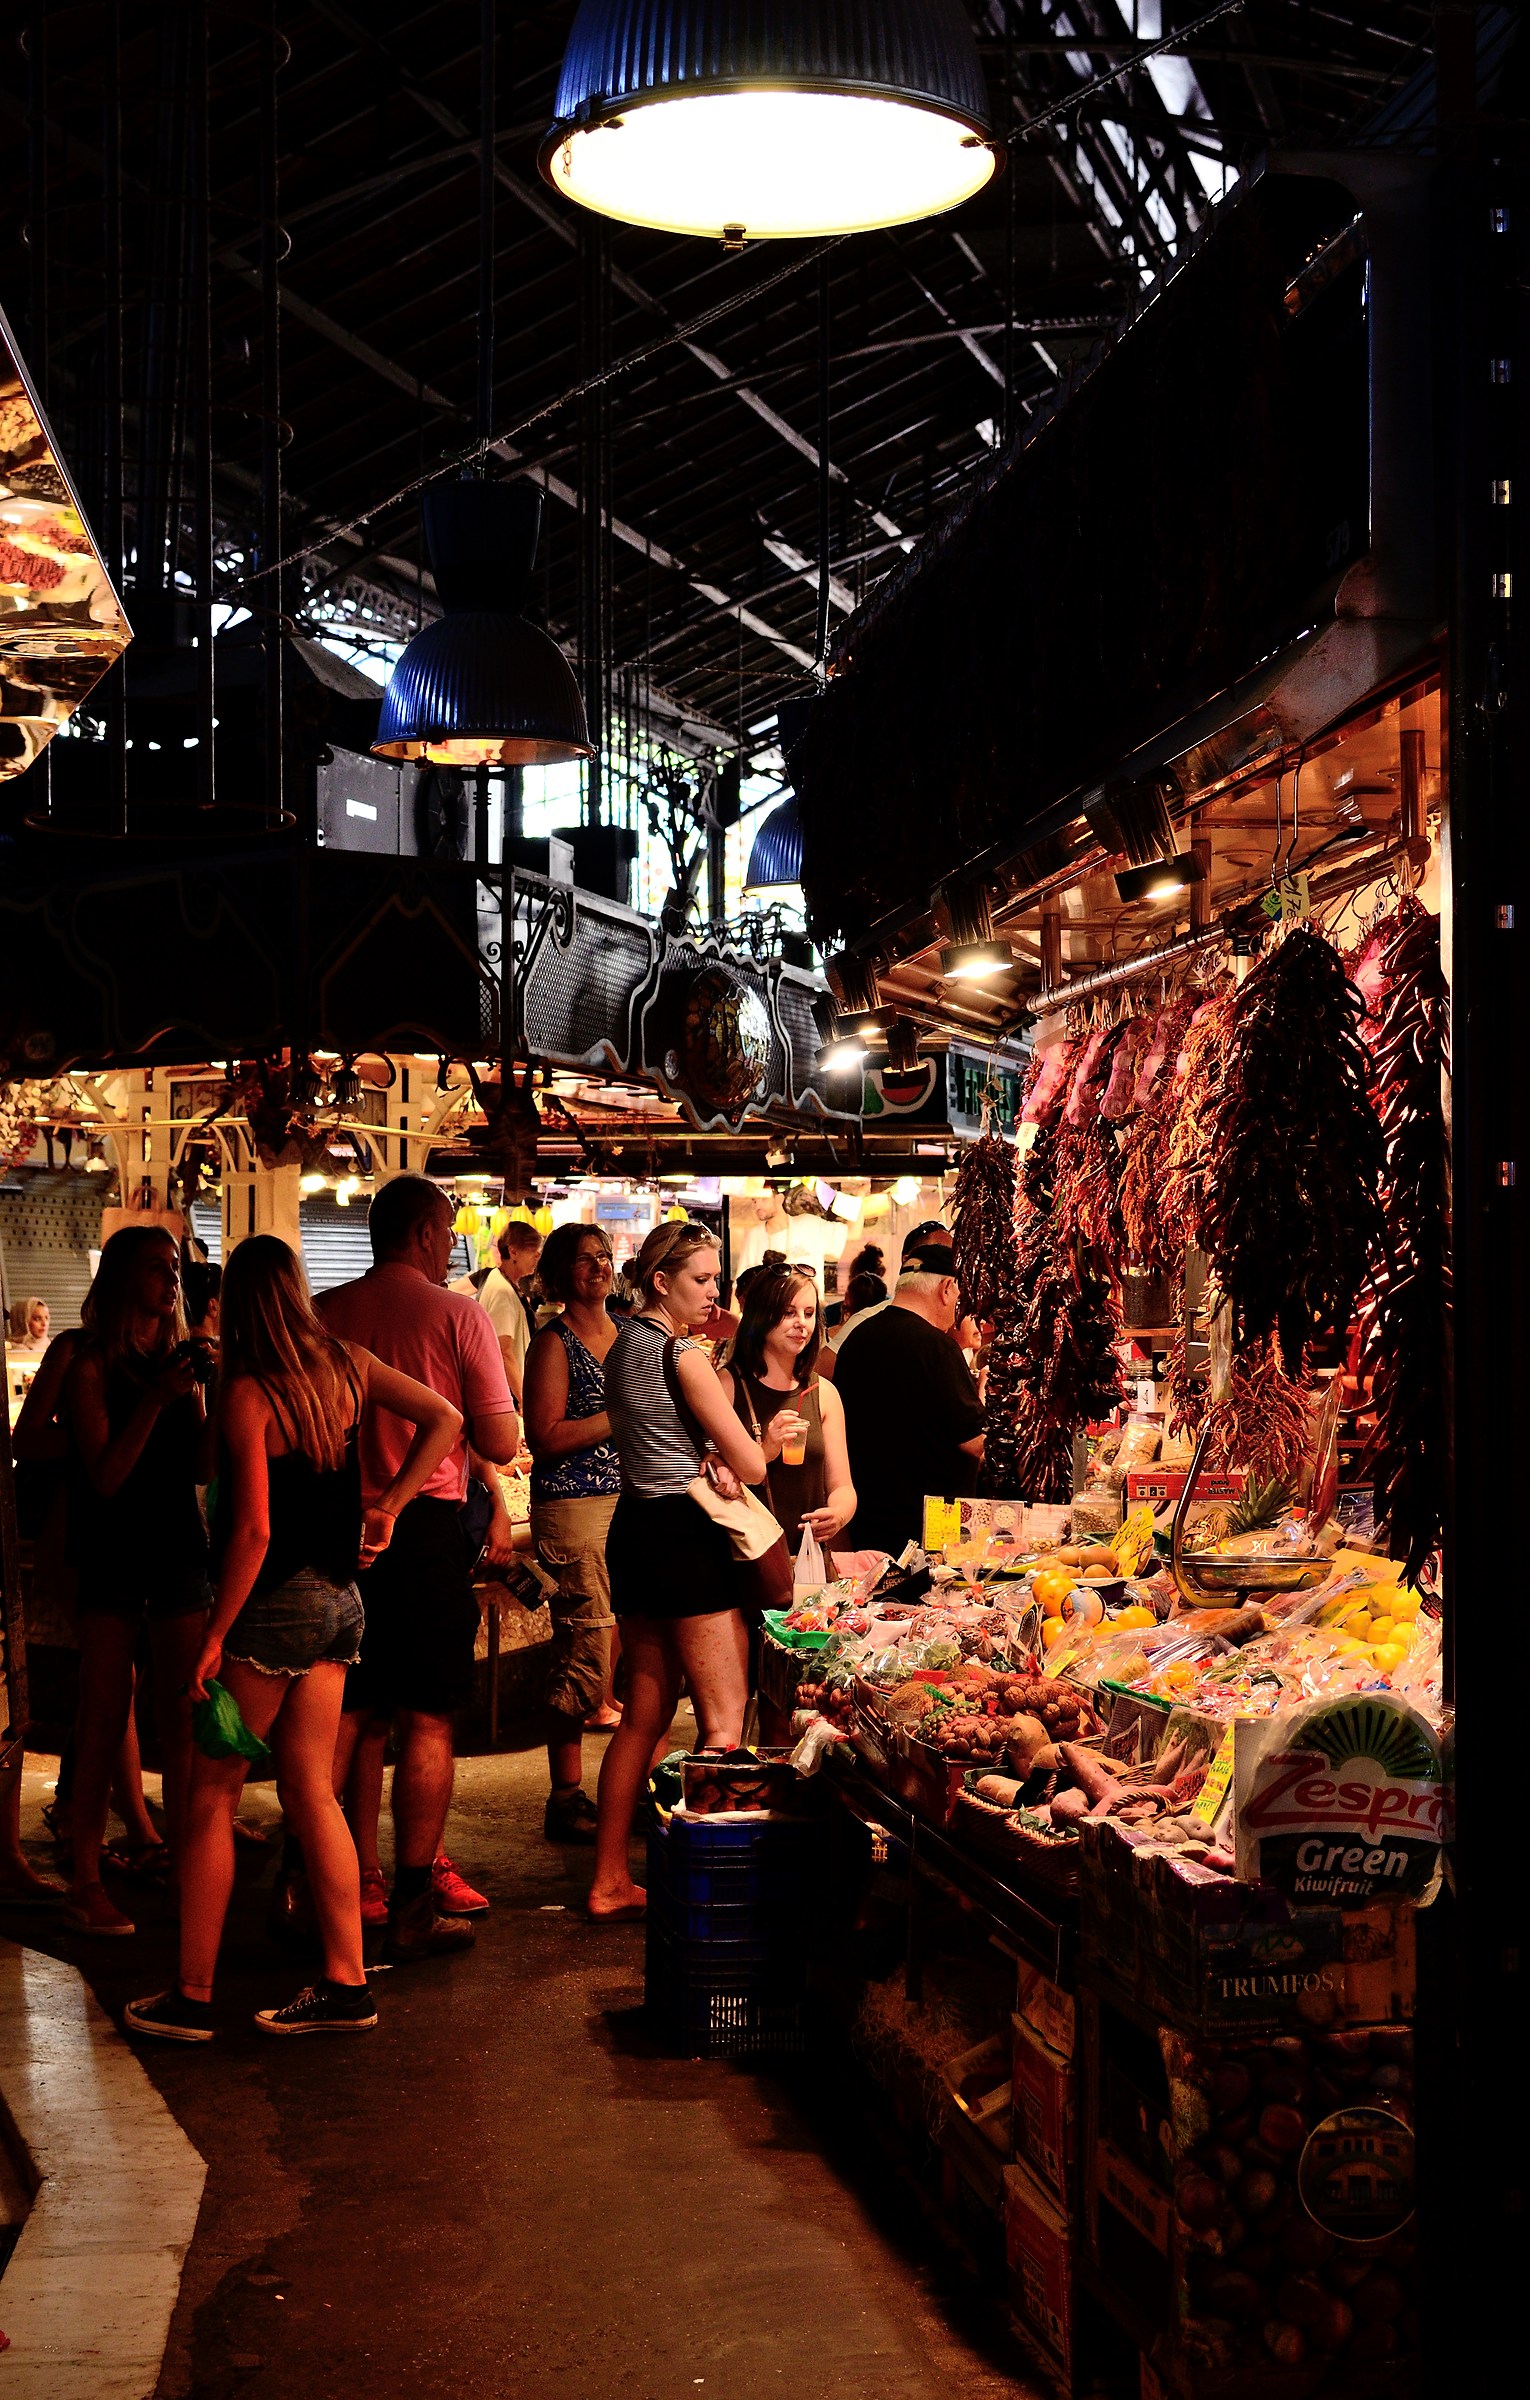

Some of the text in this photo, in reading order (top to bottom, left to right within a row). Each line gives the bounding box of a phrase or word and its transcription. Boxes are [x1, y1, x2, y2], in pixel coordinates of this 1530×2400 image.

[1208, 1487, 1236, 1495] MASTER
[1296, 1839, 1409, 1878] Green
[1294, 1875, 1374, 1897] Kiwifruit
[1218, 1972, 1334, 1998] TRUMFOS
